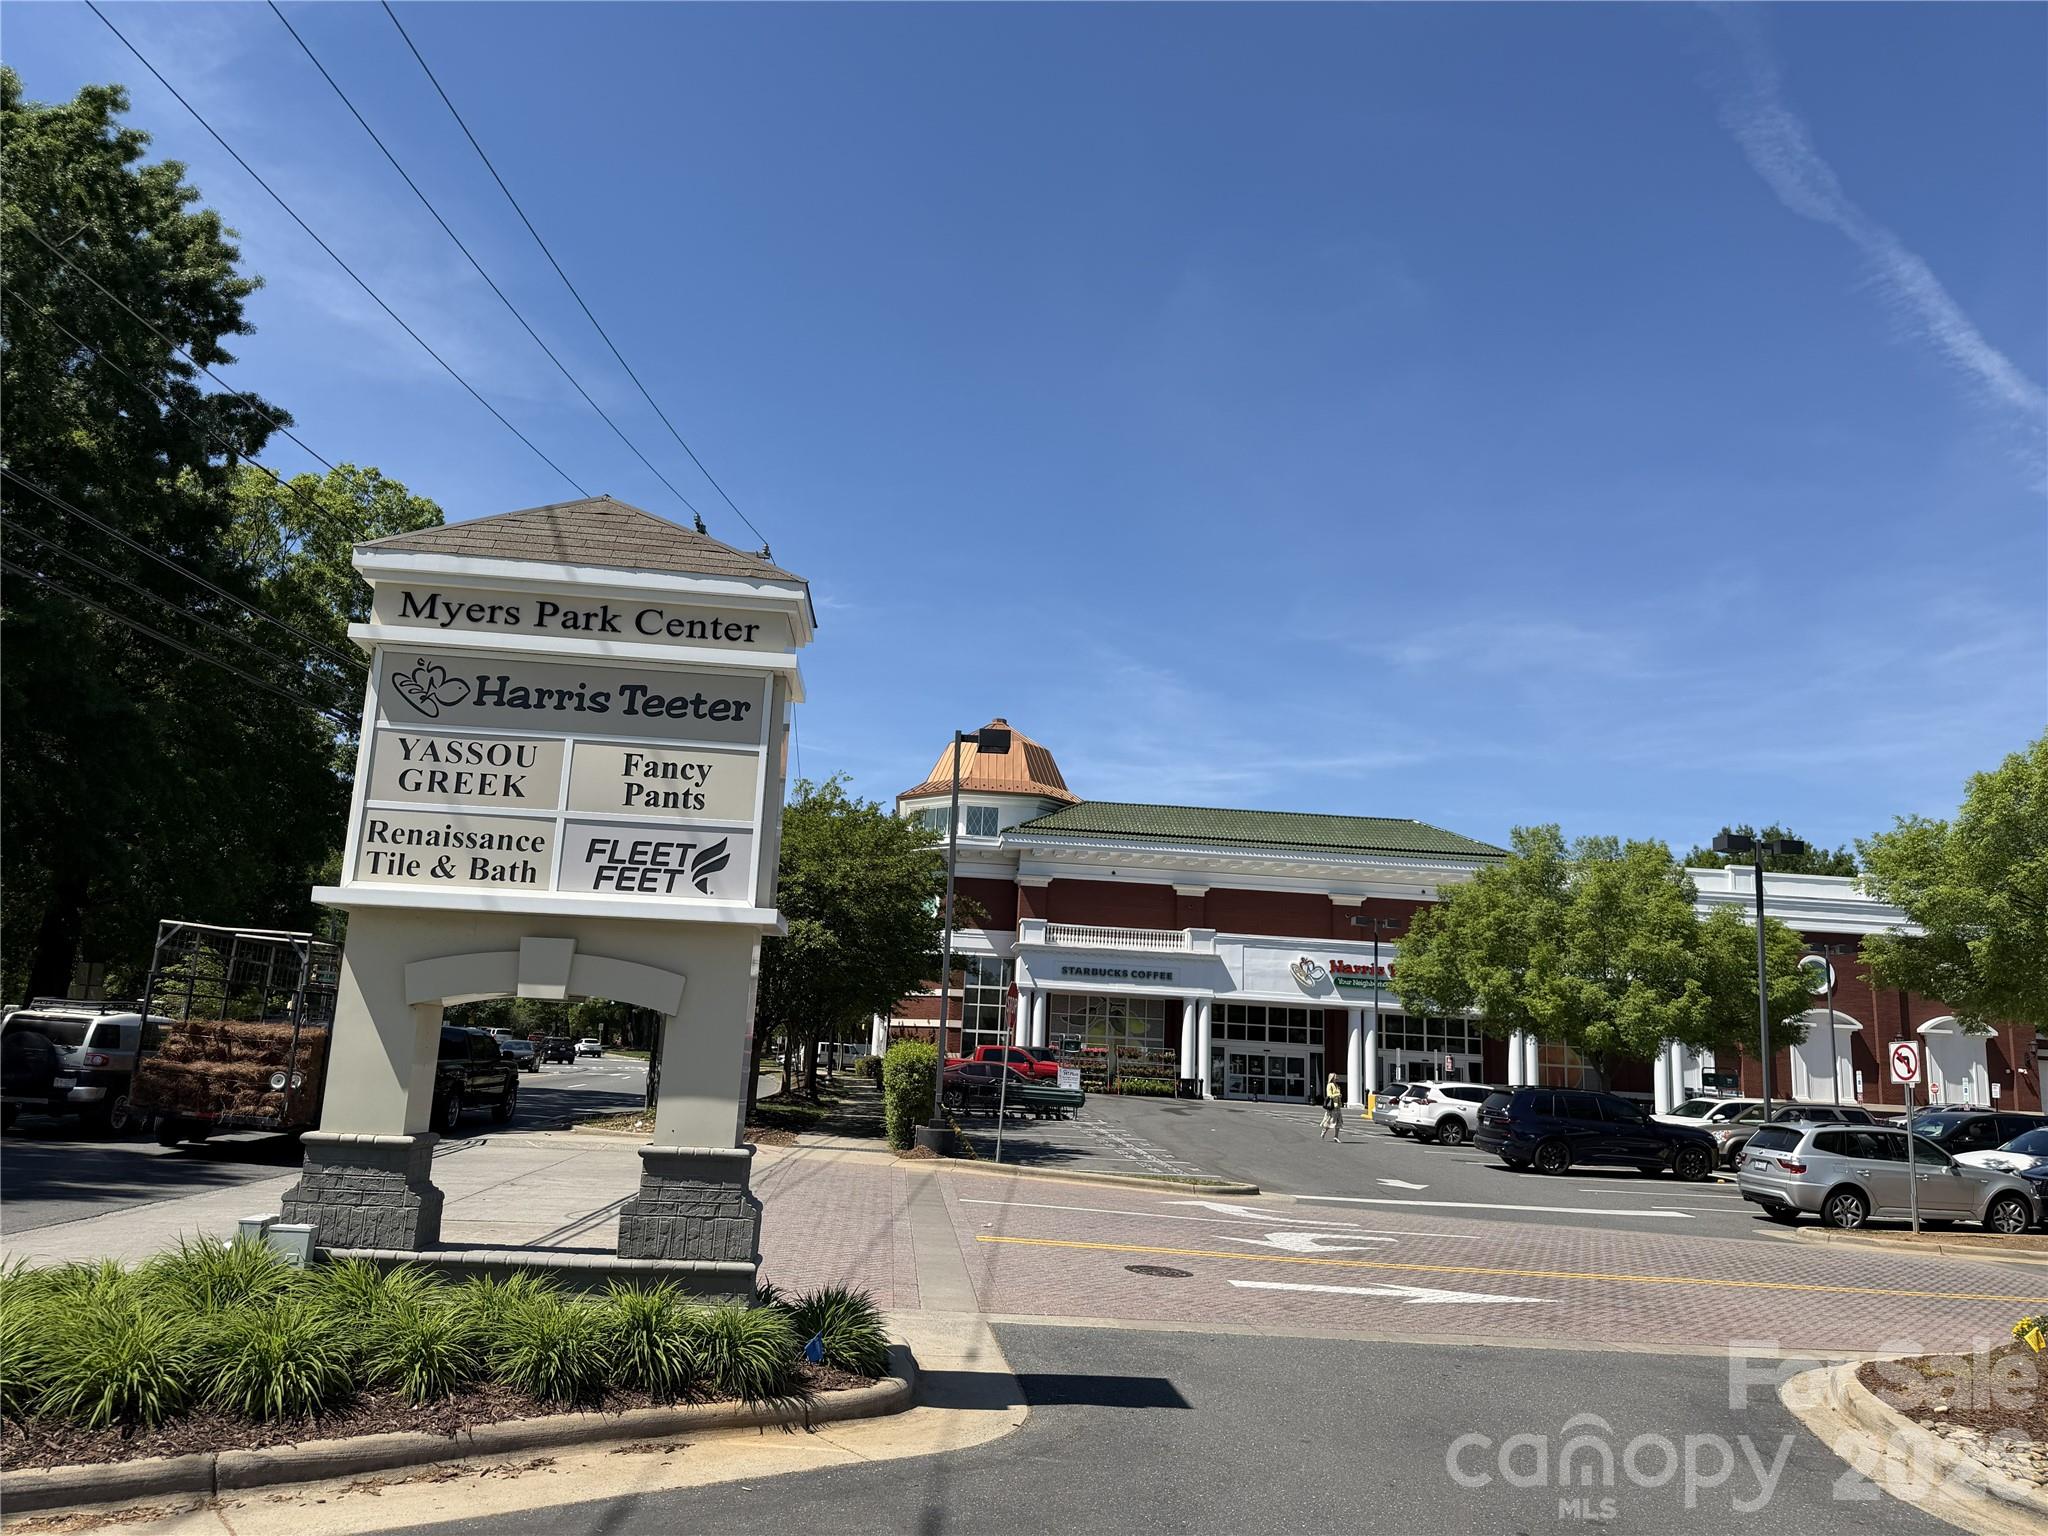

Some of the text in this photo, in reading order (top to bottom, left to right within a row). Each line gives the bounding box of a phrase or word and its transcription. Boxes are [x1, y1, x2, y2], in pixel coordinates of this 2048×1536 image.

[398, 591, 760, 643] Myers Park Center
[473, 675, 752, 723] Harris Teeter
[398, 737, 538, 769] YASSOU
[398, 768, 528, 799] GREEK
[621, 753, 713, 788] Fancy
[622, 782, 706, 811] Pants
[367, 819, 546, 853] Renaissance
[367, 850, 537, 884] Tile & Bath
[585, 838, 697, 868] FLEET
[593, 864, 685, 894] FEET
[1061, 966, 1173, 980] STARBUCKS COFFEE
[1329, 959, 1385, 976] Harris
